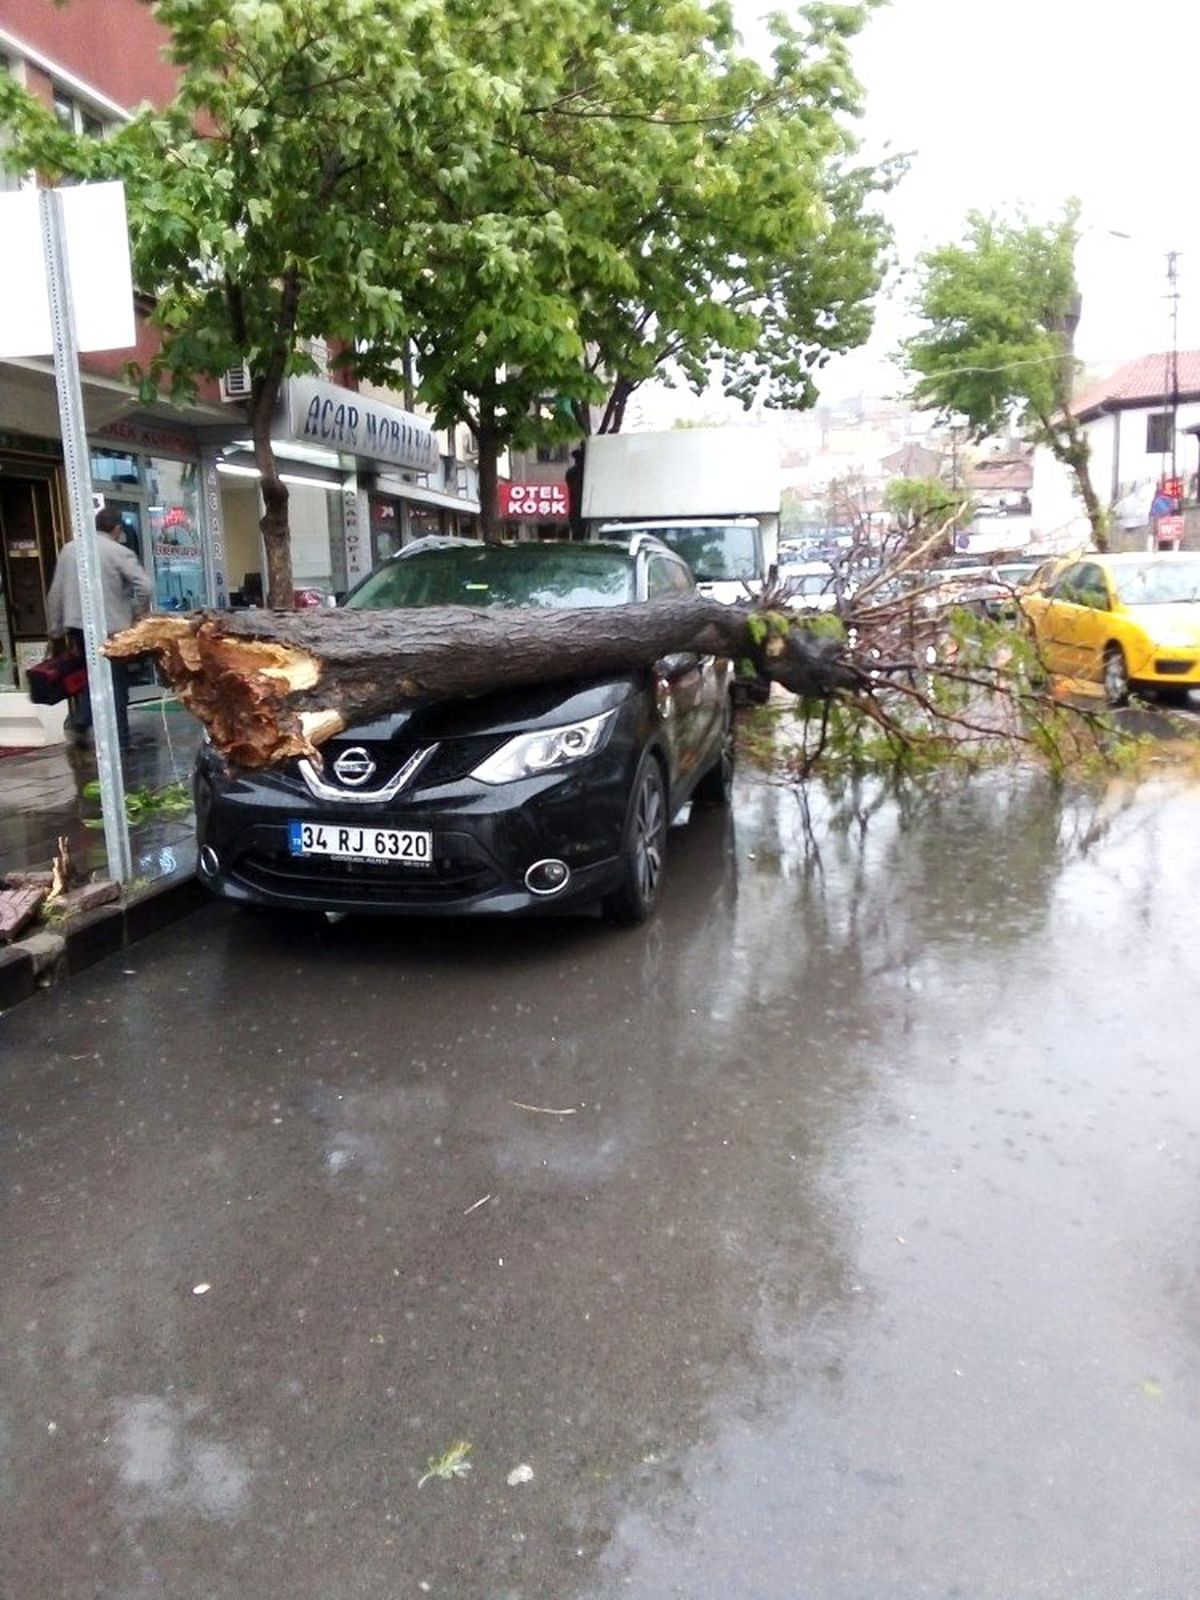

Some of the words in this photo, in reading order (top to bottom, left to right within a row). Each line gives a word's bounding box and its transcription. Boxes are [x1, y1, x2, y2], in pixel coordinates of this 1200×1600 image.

[304, 395, 359, 446] ACAR
[510, 486, 565, 500] OTEL
[303, 826, 328, 849] 34
[338, 829, 364, 853] RJ
[375, 832, 427, 857] 6320
